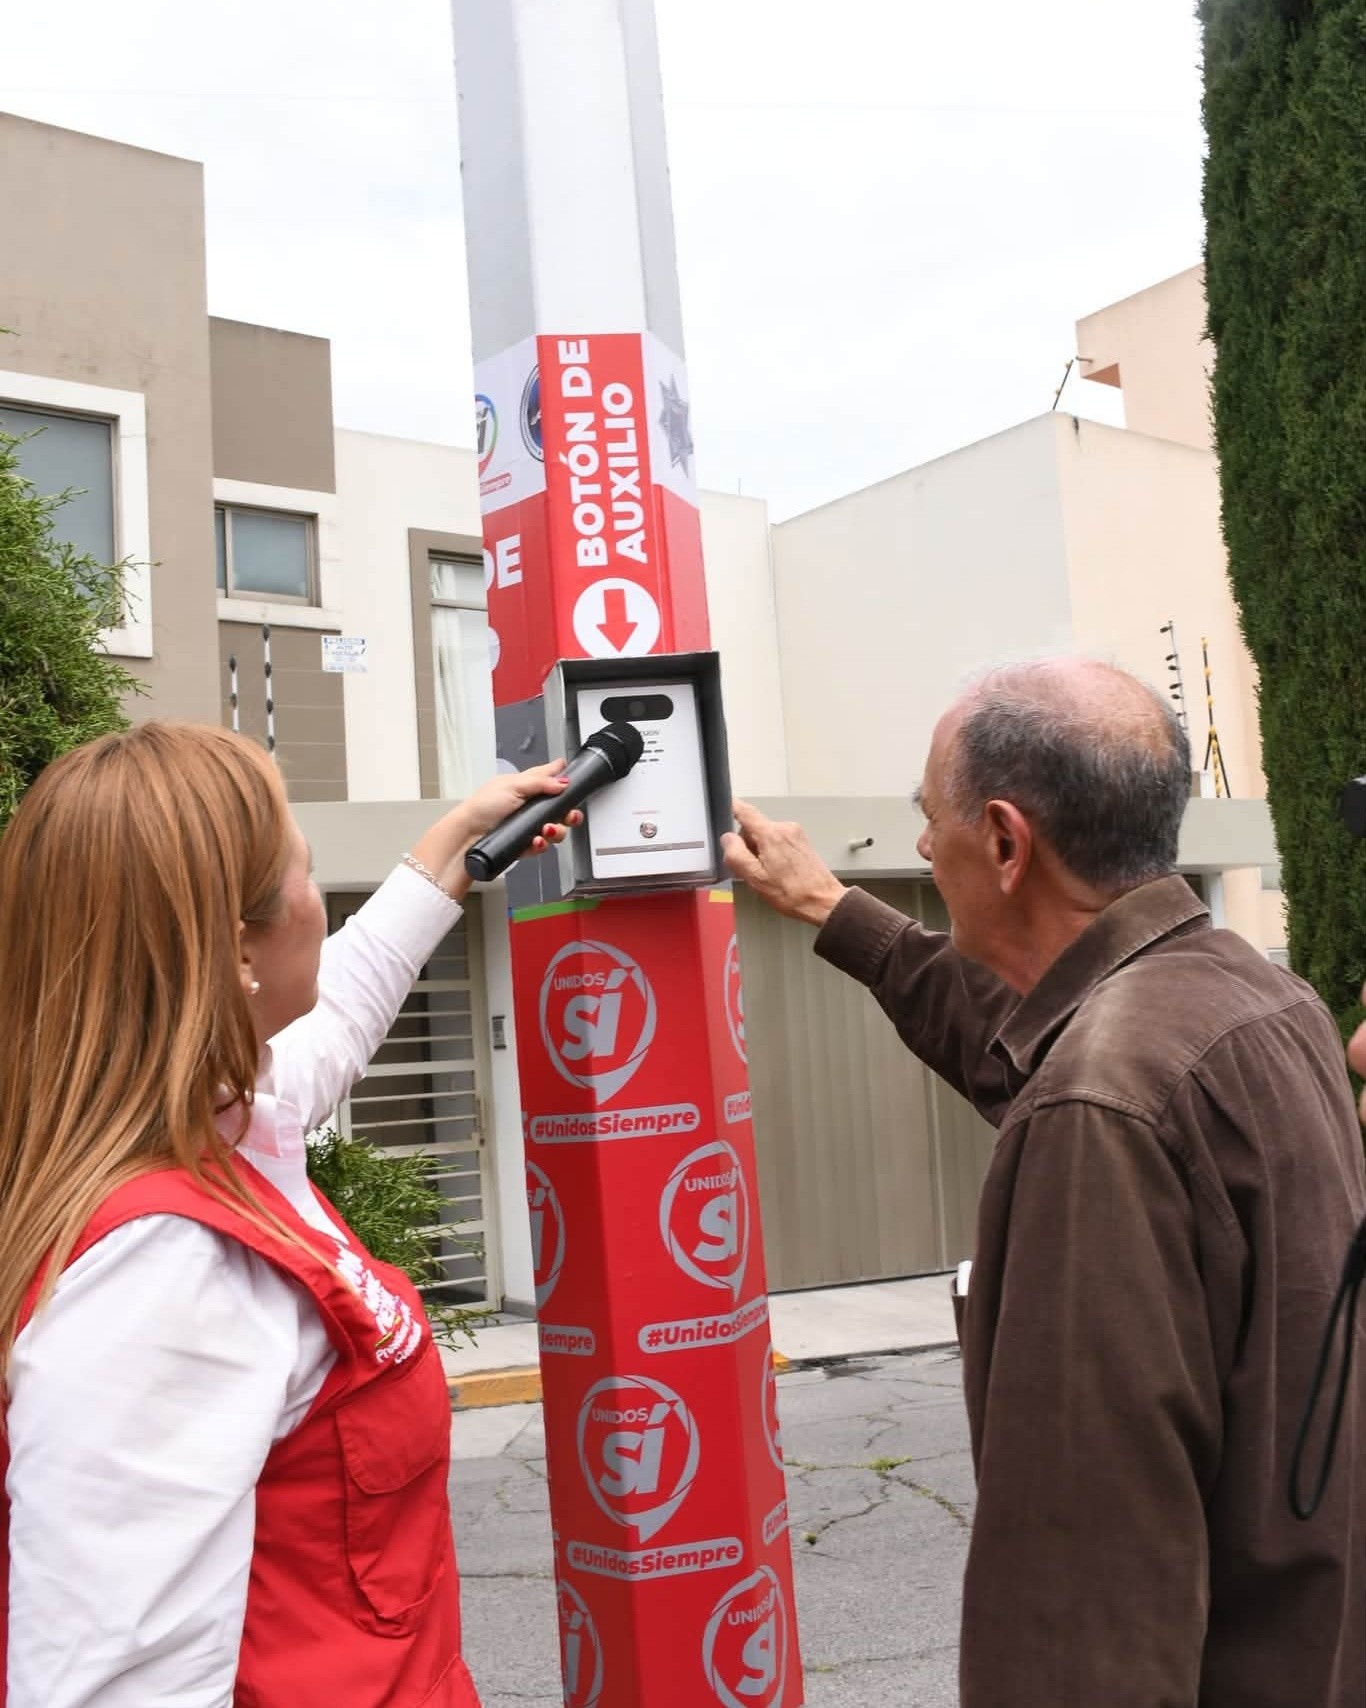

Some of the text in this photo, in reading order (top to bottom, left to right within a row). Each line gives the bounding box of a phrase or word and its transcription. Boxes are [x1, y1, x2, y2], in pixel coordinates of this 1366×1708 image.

[558, 339, 608, 567] BOTÓN DE
[602, 383, 648, 563] AUXILIO
[554, 972, 605, 991] UNIDOS
[535, 1111, 697, 1138] #UnidosSiempre
[592, 1407, 648, 1424] UNIDOS
[572, 1545, 738, 1575] #UnidosSiempre
